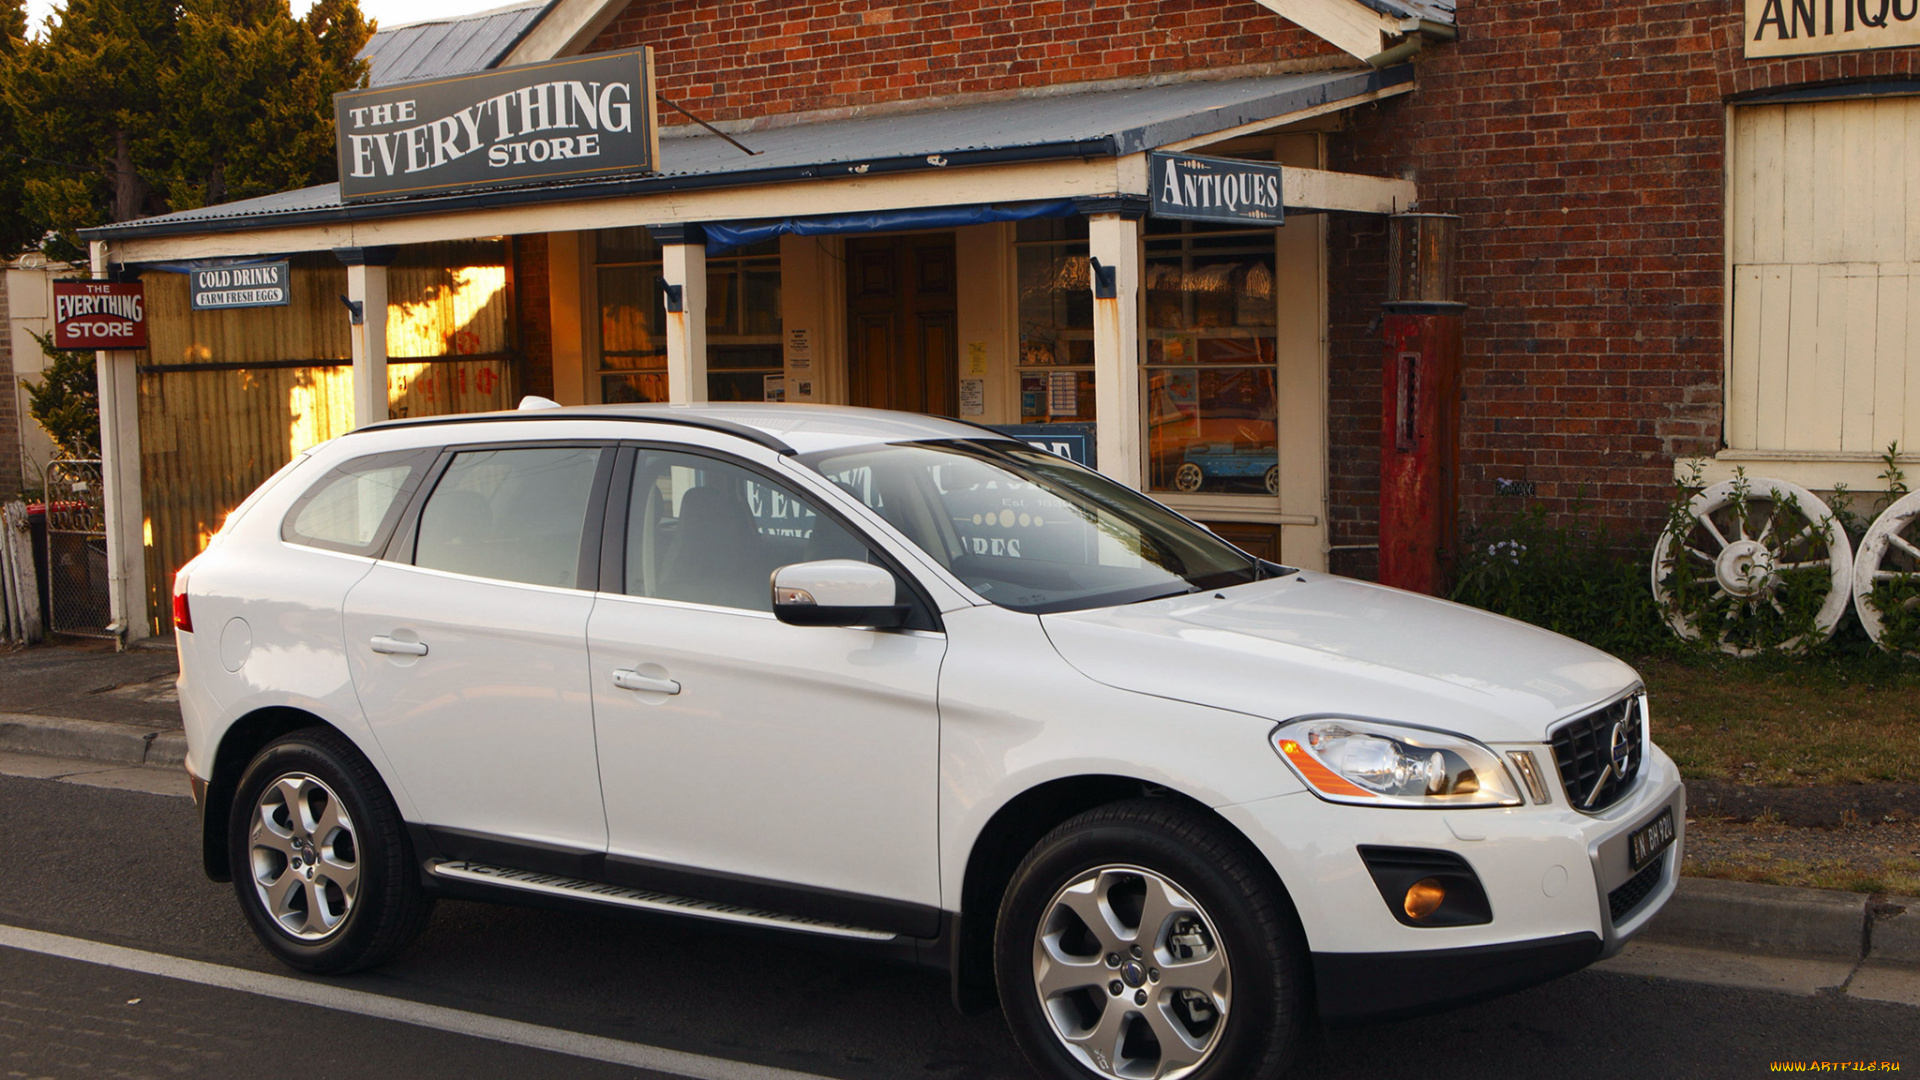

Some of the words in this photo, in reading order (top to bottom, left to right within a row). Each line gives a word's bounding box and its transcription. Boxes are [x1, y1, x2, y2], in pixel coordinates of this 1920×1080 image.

[349, 100, 417, 129] THE
[348, 80, 632, 178] EVERYTHING
[488, 133, 600, 168] STORE
[86, 284, 111, 294] THE
[199, 268, 231, 289] COLD
[233, 266, 279, 287] DRINKS
[56, 294, 143, 324] EVERYTHING
[200, 292, 225, 305] FARM
[226, 291, 254, 303] FRESH
[255, 289, 279, 302] EGGS
[66, 321, 134, 339] STORE
